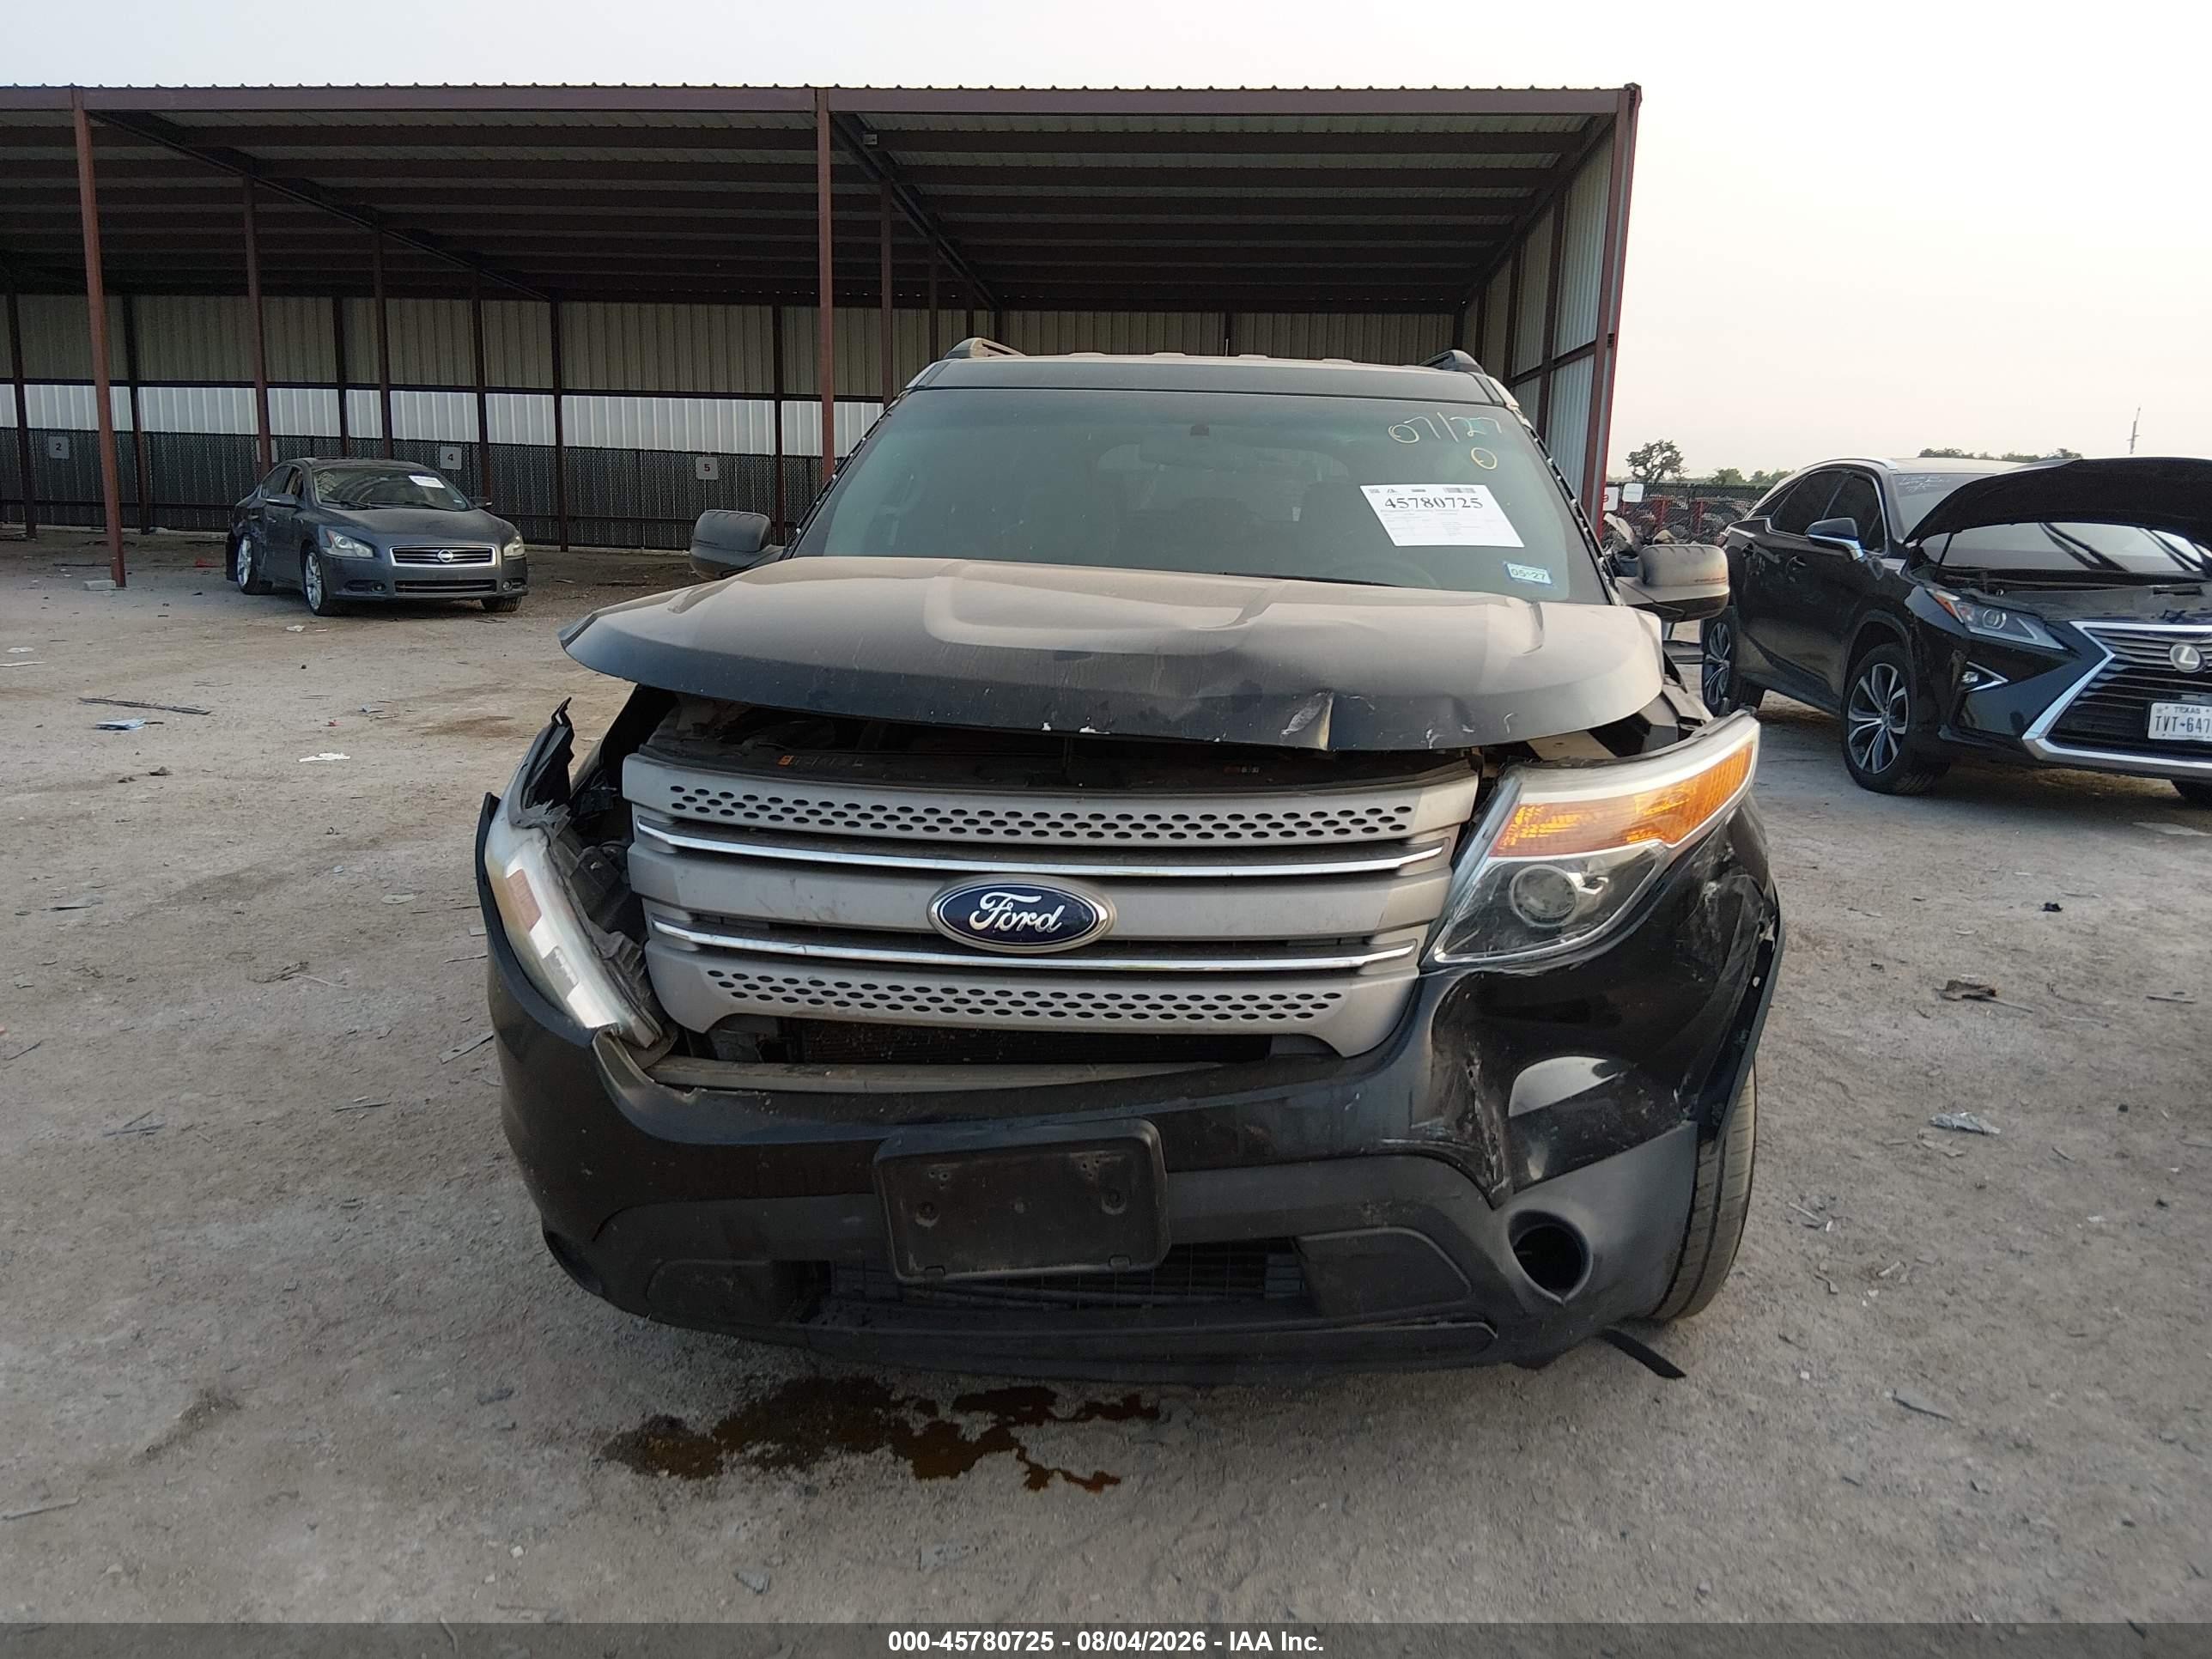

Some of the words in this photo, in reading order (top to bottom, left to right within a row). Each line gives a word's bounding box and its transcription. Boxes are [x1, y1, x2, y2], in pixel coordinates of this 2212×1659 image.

[55, 442, 62, 452] 2
[704, 464, 711, 472] 5
[1384, 497, 1484, 509] 45780725
[2173, 706, 2201, 714] TEXAS
[969, 891, 1066, 933] Ford
